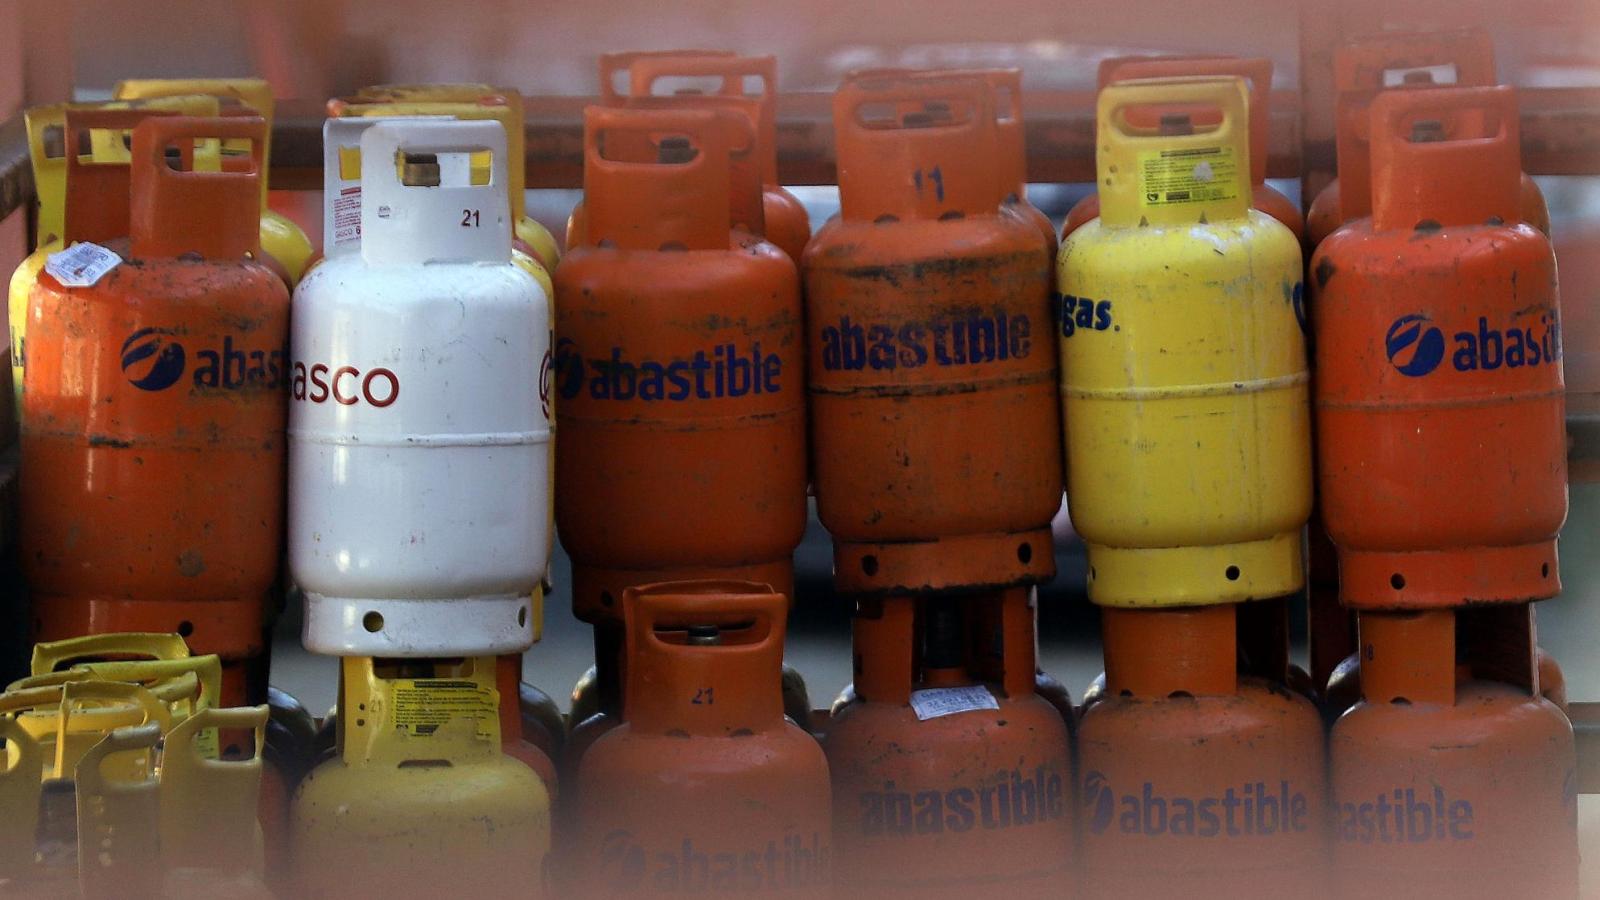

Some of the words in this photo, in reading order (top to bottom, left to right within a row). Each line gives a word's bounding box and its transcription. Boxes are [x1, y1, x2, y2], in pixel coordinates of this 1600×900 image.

[461, 209, 480, 227] 21
[820, 312, 1032, 370] abastible
[589, 343, 782, 401] abastible
[691, 686, 714, 705] 21
[861, 768, 1064, 836] abastible
[1119, 780, 1308, 838] abastible
